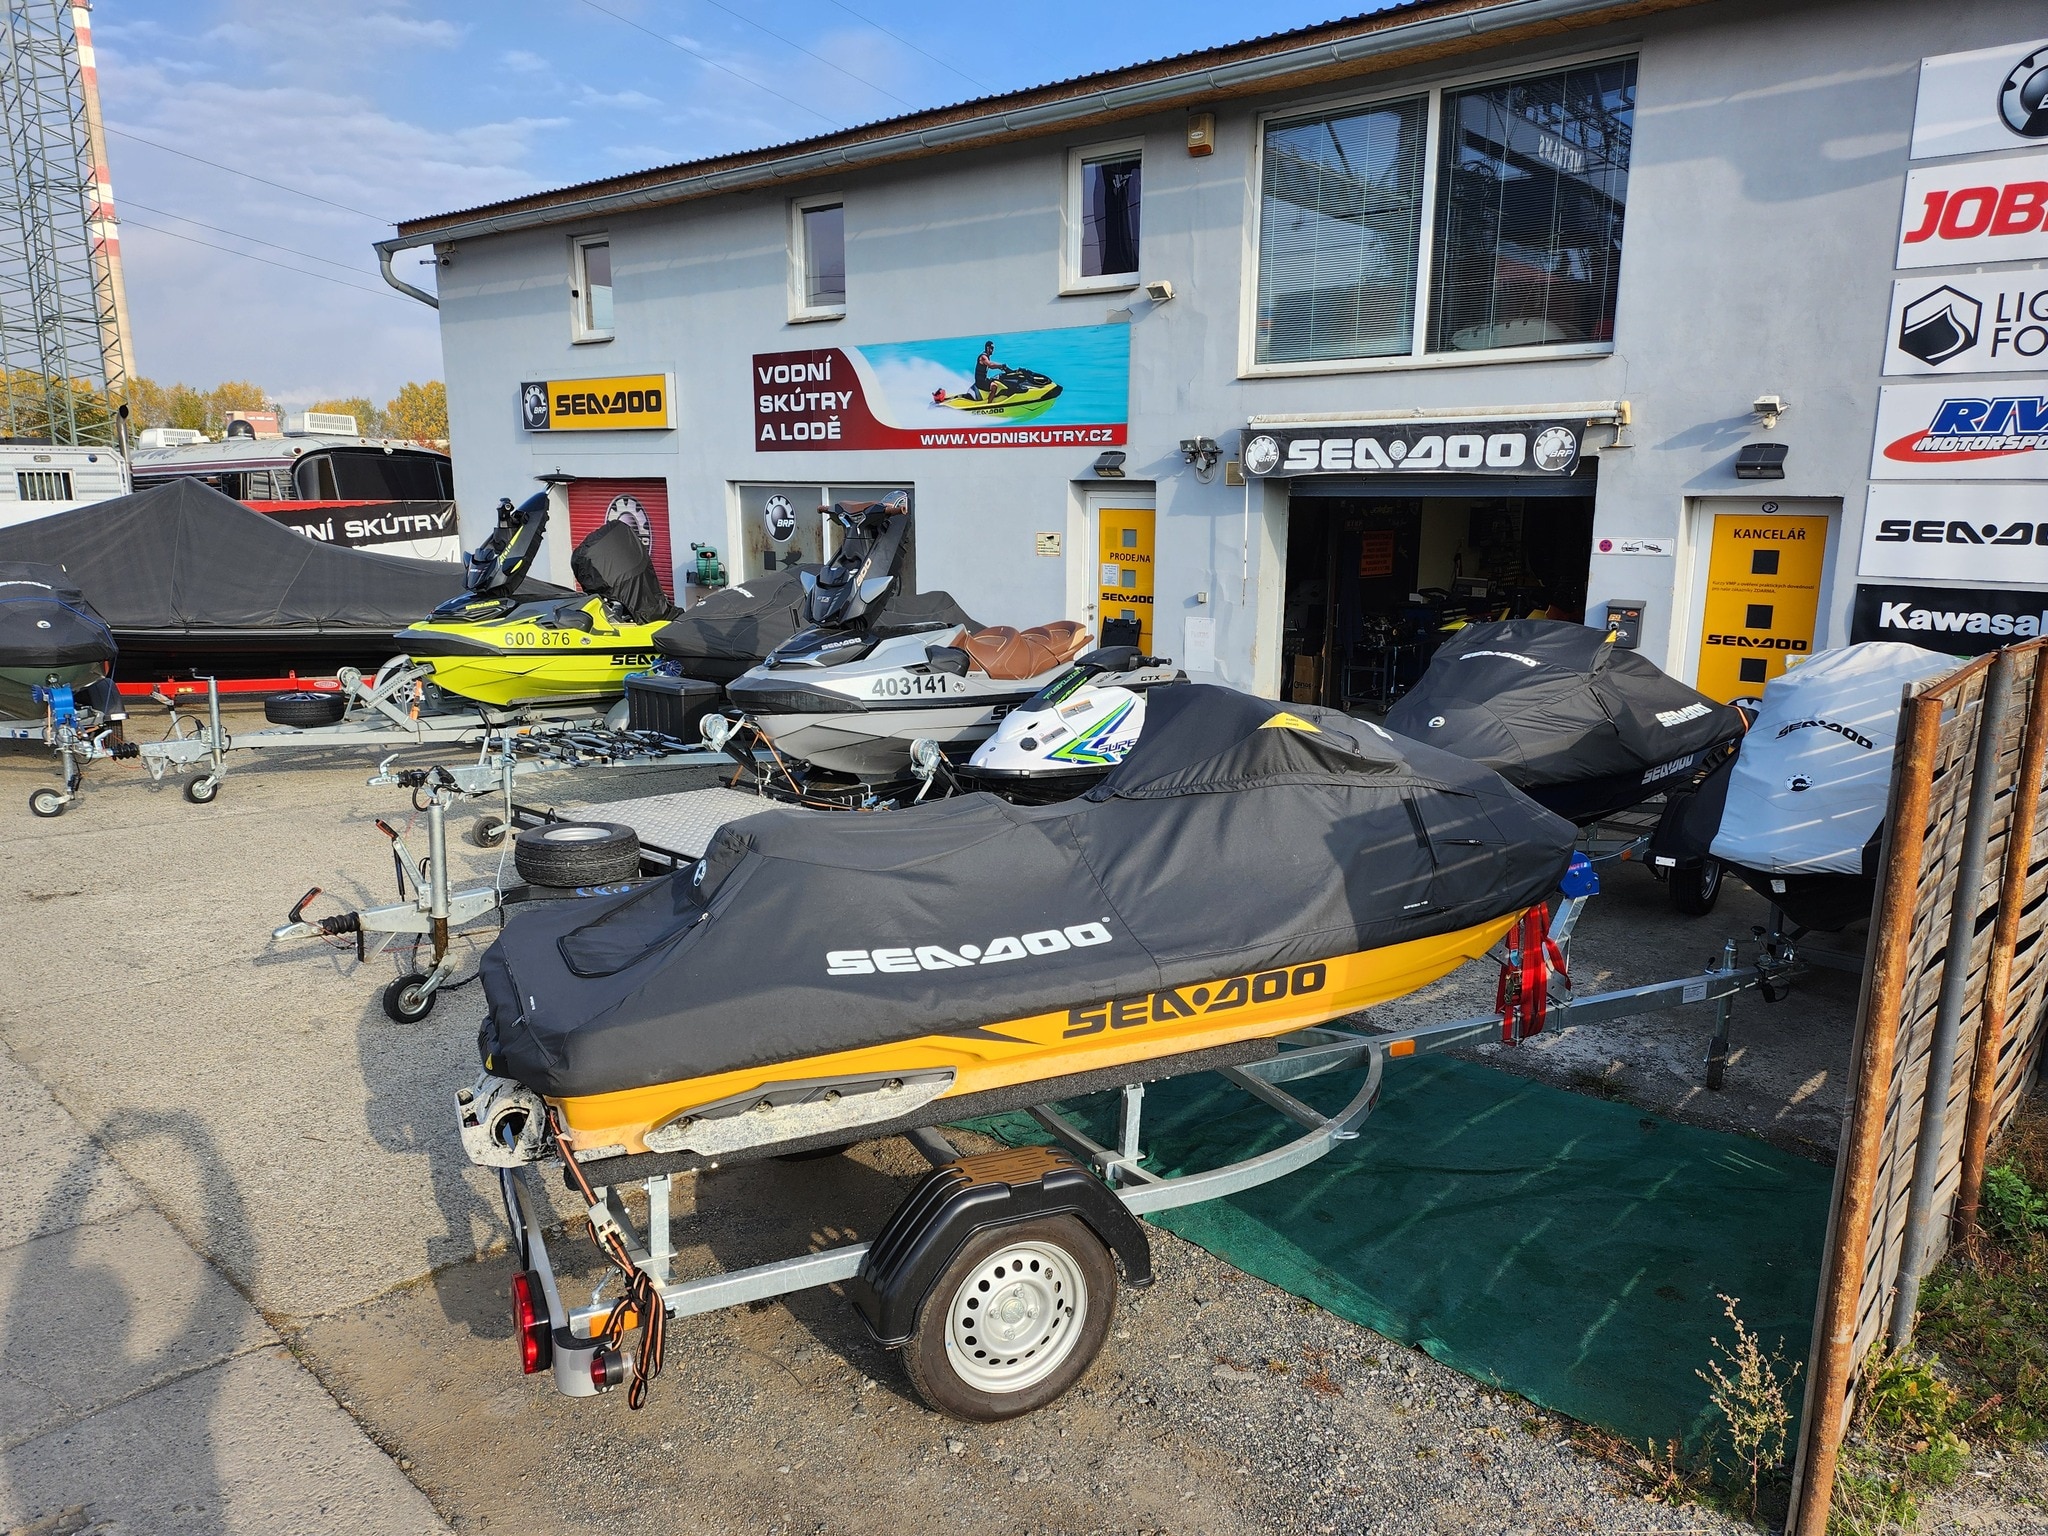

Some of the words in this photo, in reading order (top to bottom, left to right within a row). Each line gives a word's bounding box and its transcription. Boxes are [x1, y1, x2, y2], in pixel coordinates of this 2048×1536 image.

[1903, 181, 2048, 244] JOB
[758, 355, 832, 384] VODNÍ
[533, 406, 547, 414] BRP
[759, 388, 853, 414] SKÚTRY
[760, 424, 777, 441] A
[781, 415, 842, 441] LODĚ
[920, 428, 1113, 446] WWW.VODNISKUTRY.CZ
[1549, 449, 1573, 458] BRP
[344, 513, 447, 538] SKÚTRY
[776, 519, 795, 528] BRP
[1733, 527, 1806, 540] KANCELÁŘ
[1109, 552, 1151, 563] PRODEJNA
[504, 632, 535, 646] 600
[542, 632, 570, 646] 876
[872, 675, 947, 697] 403141
